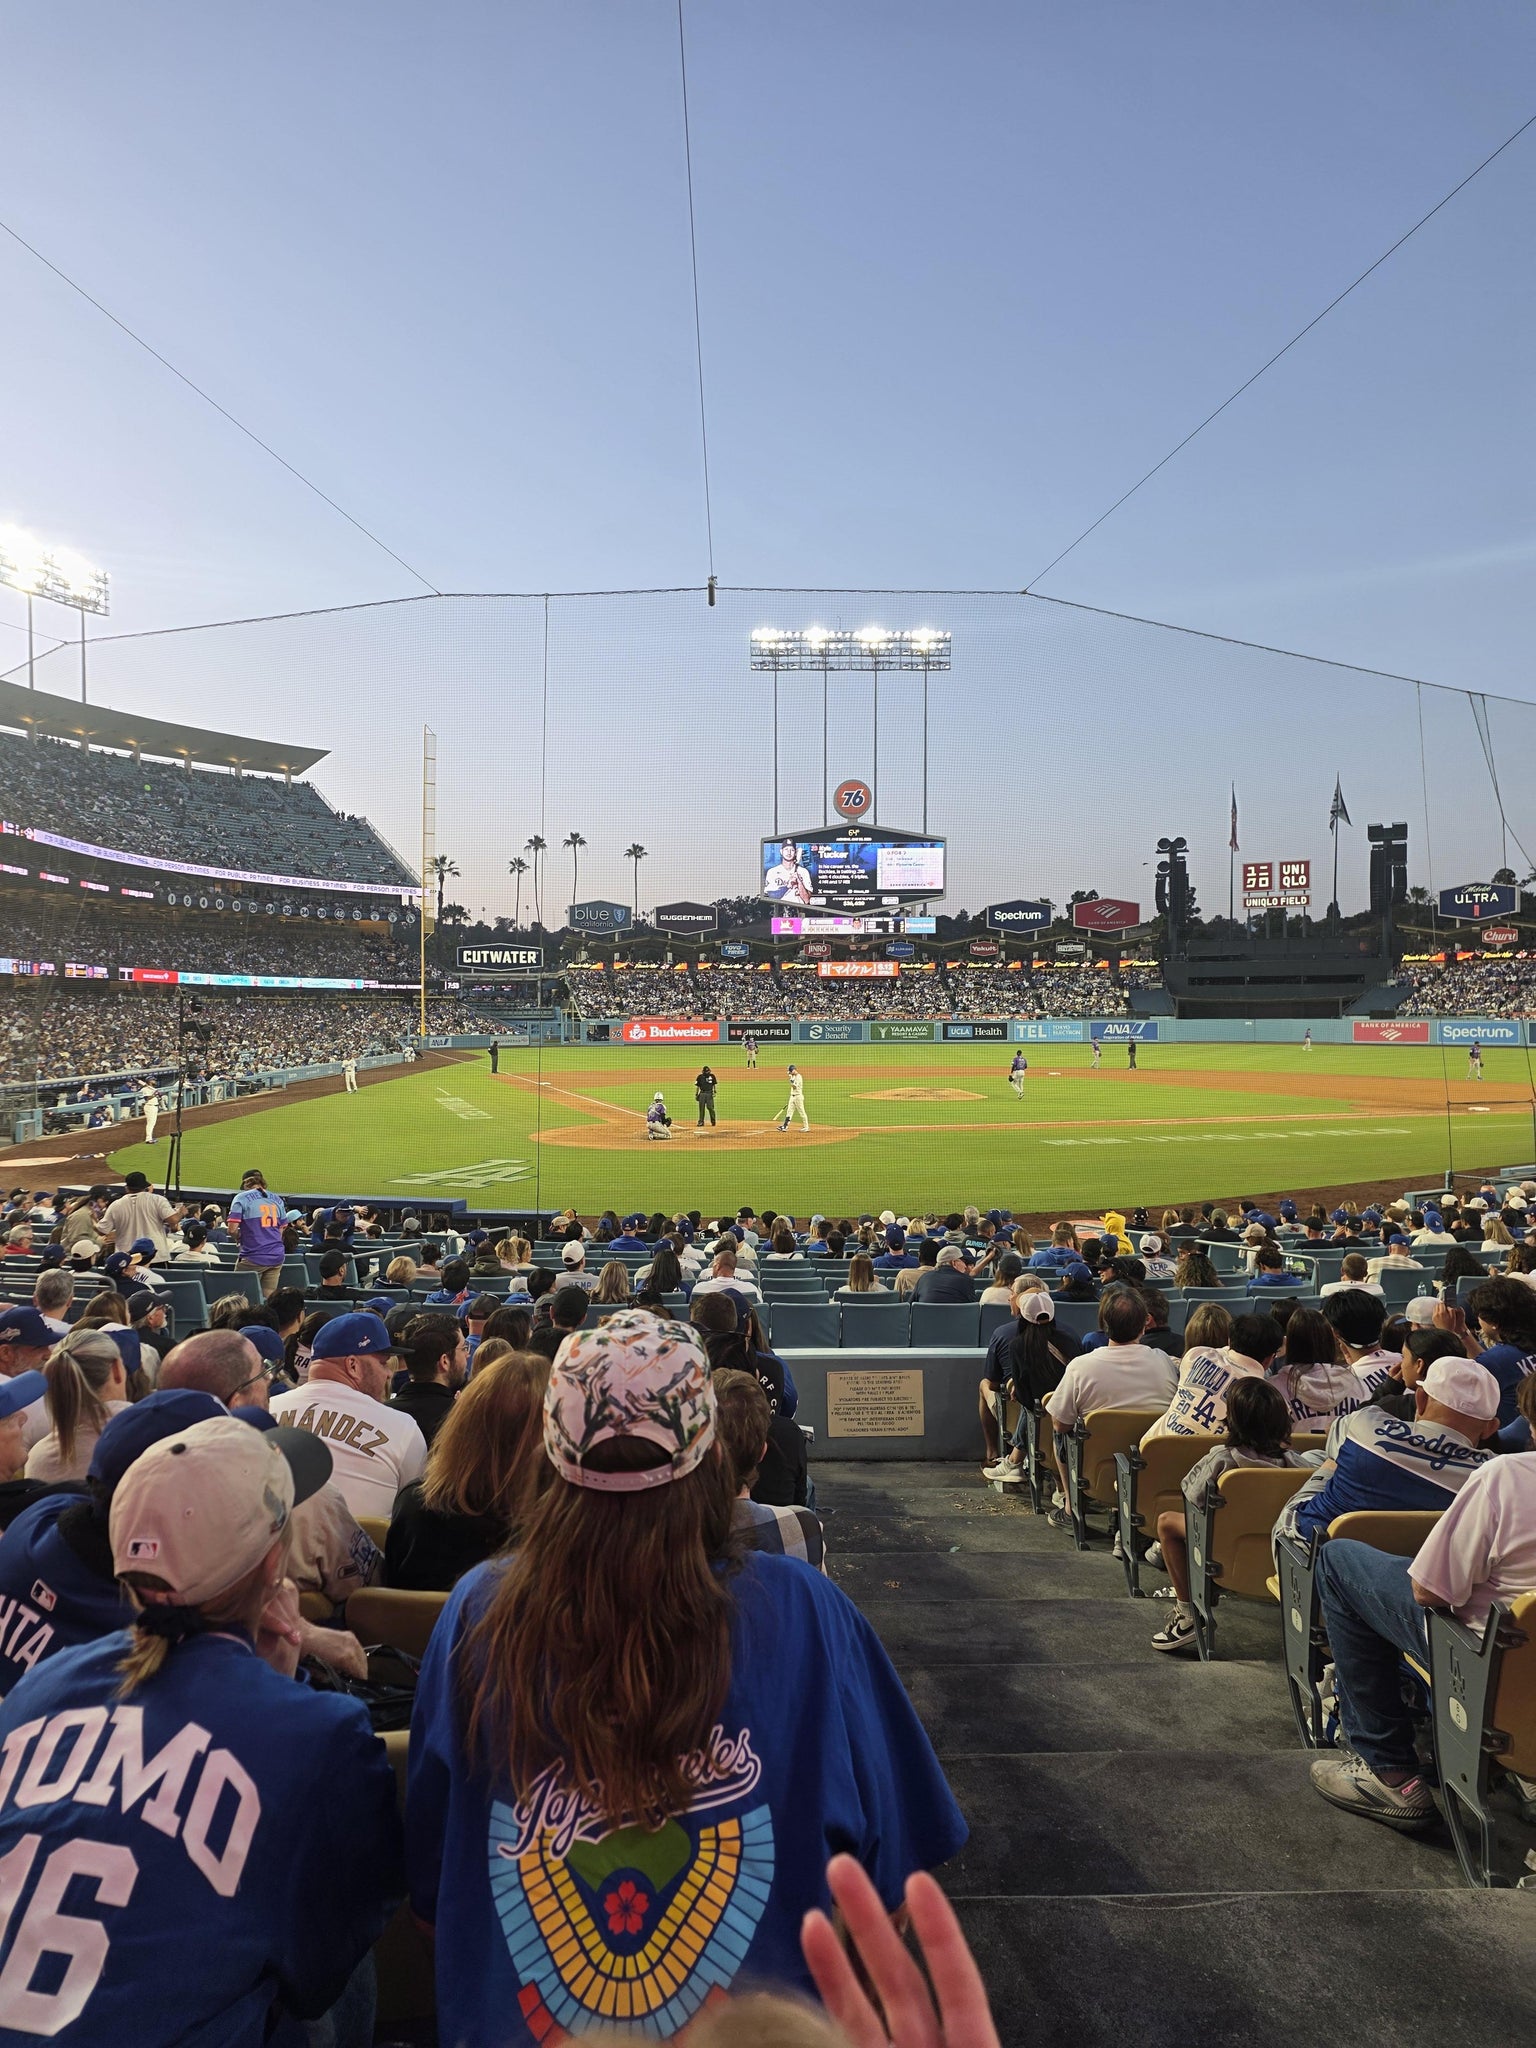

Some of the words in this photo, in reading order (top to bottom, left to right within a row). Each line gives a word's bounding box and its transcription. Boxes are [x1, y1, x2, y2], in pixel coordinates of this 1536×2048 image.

[841, 790, 864, 808] 76
[1282, 864, 1305, 875] UNI
[1282, 875, 1307, 888] QLO
[1246, 898, 1278, 907] UNIQLO
[1280, 897, 1307, 905] FIELD
[1455, 892, 1499, 904] ULTRA
[335, 910, 344, 918] 42
[575, 906, 609, 921] blue
[994, 911, 1042, 922] Spectrum
[1484, 930, 1516, 941] Churu
[463, 950, 536, 964] CUTWATER
[650, 1026, 713, 1037] Budweiser
[825, 1024, 852, 1033] Security
[975, 1028, 1002, 1036] Health
[1017, 1025, 1047, 1038] TEL
[1104, 1024, 1130, 1034] ANA
[1443, 1026, 1508, 1039] Spectrum
[259, 1203, 278, 1228] 21
[1149, 1262, 1168, 1271] KEMP
[1191, 1390, 1216, 1431] LA
[273, 1403, 389, 1457] NÁNDEZ
[1374, 1420, 1490, 1470] Dodgers
[0, 1833, 140, 2037] 16
